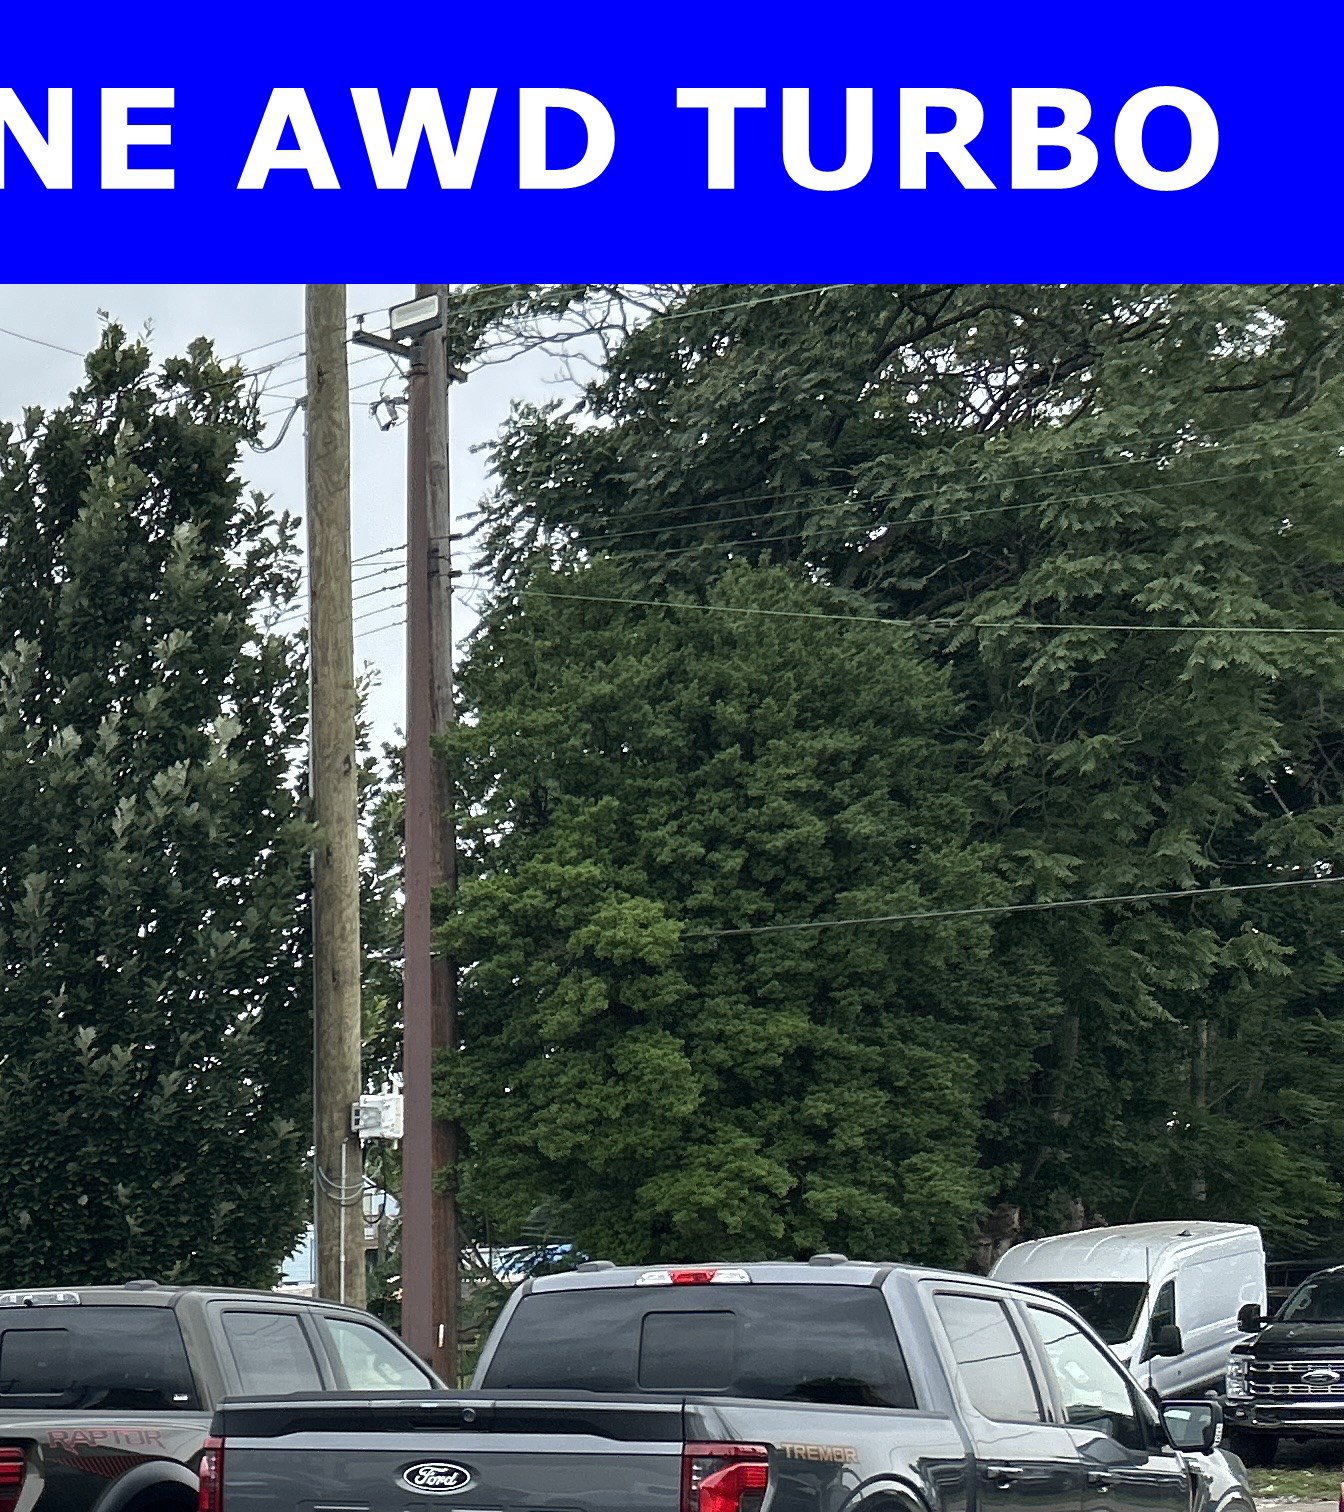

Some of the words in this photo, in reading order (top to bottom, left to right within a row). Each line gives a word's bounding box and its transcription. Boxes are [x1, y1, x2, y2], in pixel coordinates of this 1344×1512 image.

[46, 1428, 168, 1456] RAPTOR
[780, 1441, 860, 1464] TREMOR
[414, 1466, 460, 1486] Ford
